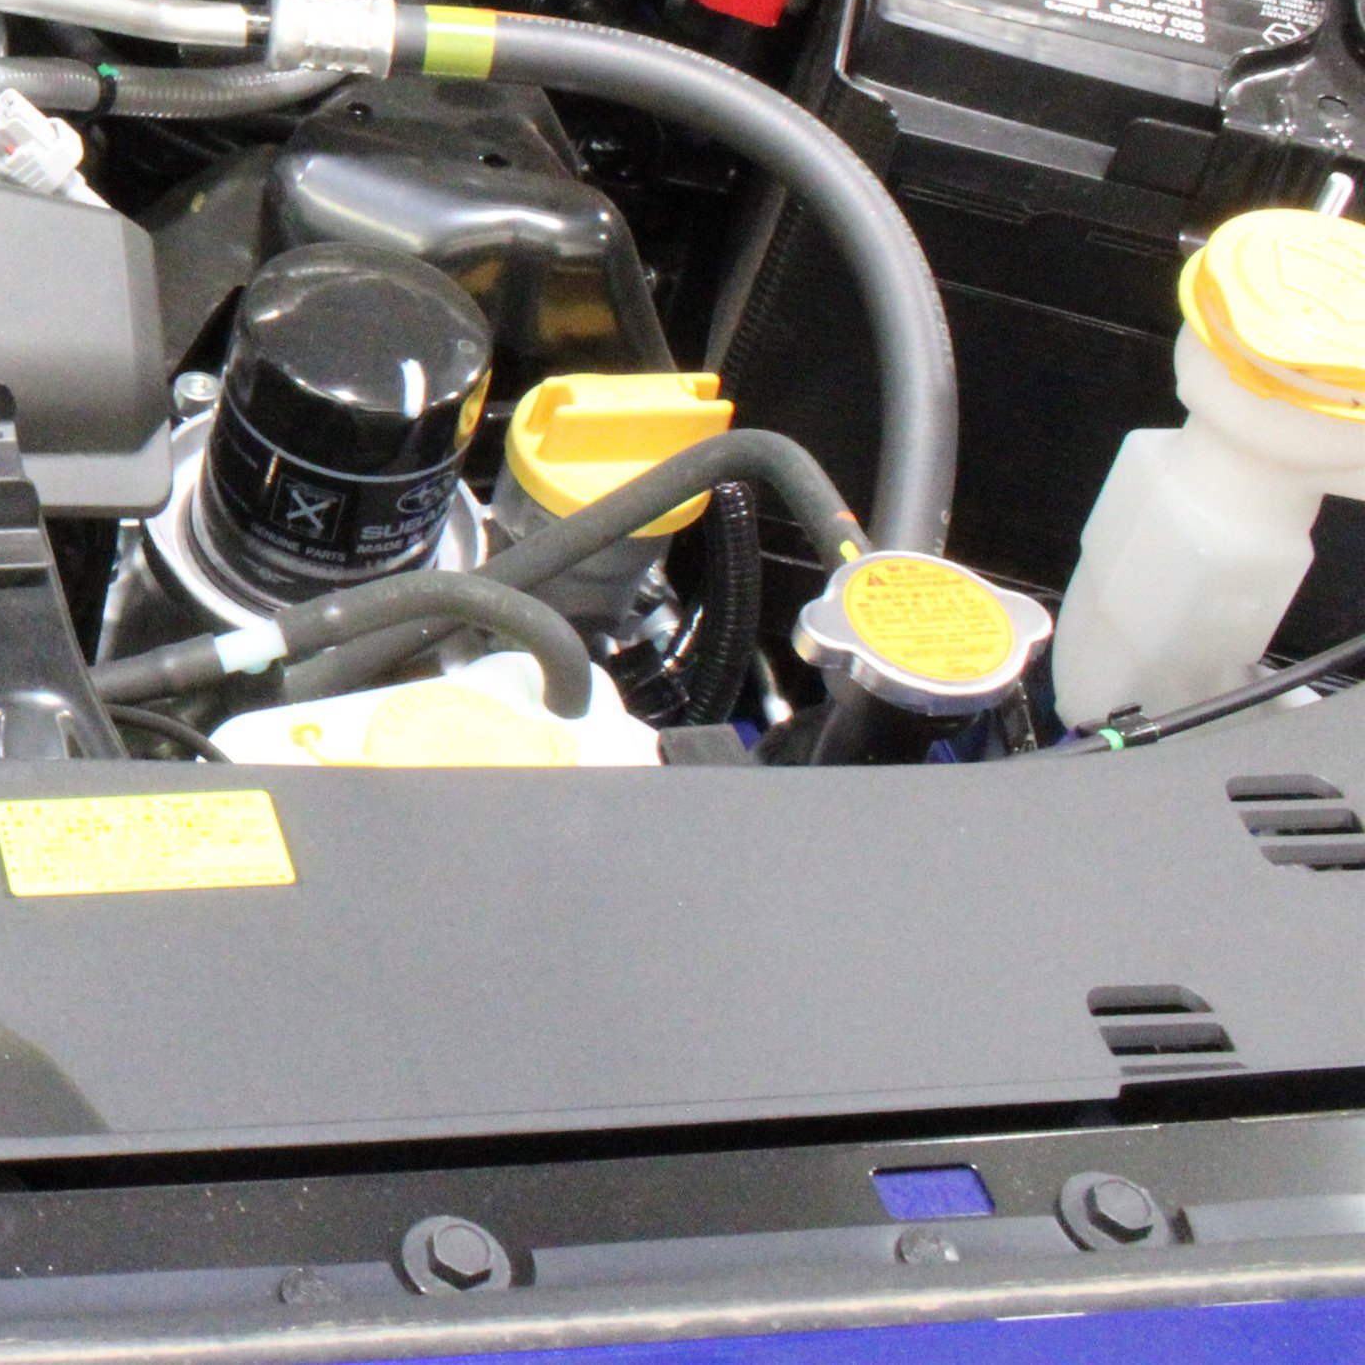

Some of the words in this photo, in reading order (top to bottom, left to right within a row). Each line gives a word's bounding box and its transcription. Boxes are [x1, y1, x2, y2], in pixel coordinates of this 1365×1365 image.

[1044, 0, 1085, 16] AMPS
[1109, 2, 1167, 24] AMPS
[1151, 1, 1204, 19] GROUP
[1086, 9, 1163, 34] CRANKING
[1164, 27, 1205, 43] COLD
[305, 546, 346, 563] PARTS
